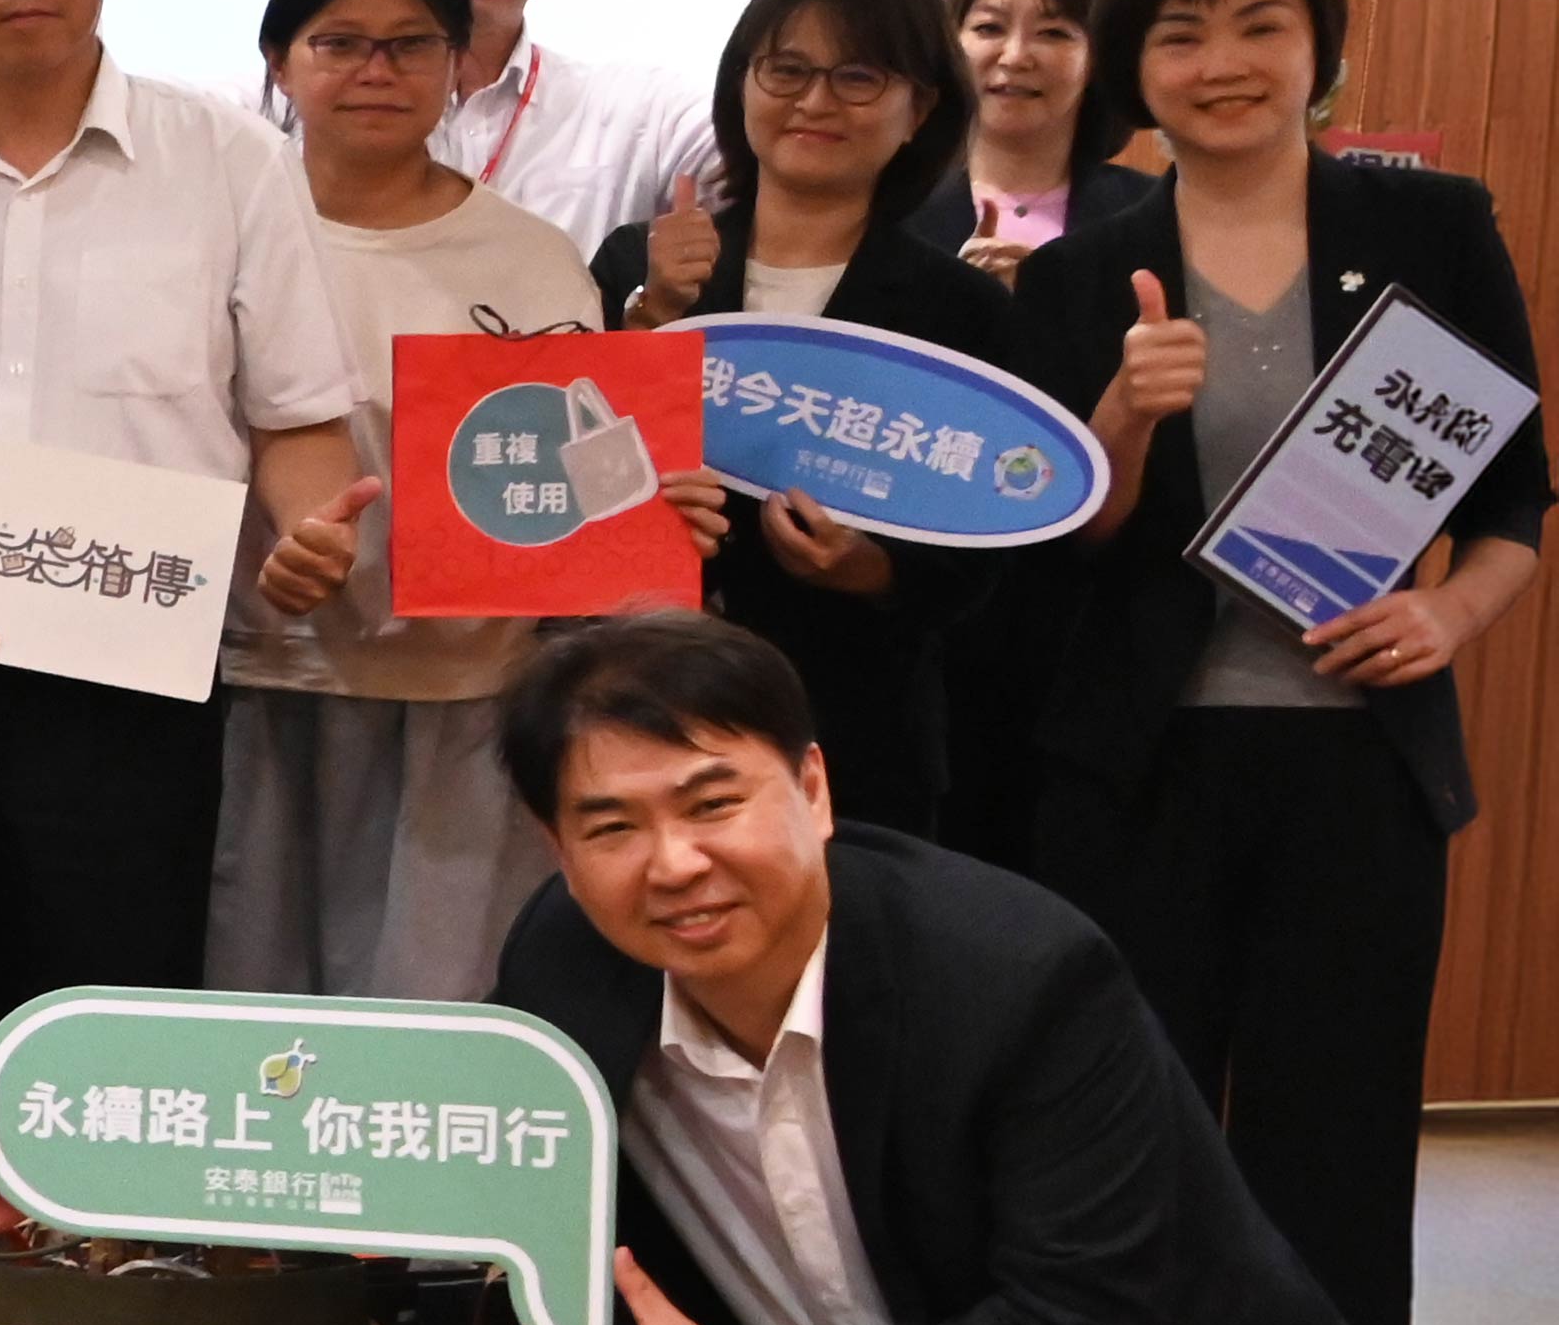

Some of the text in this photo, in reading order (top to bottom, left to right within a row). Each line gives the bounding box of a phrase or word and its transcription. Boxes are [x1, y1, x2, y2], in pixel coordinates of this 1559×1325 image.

[471, 431, 539, 467] 重複
[502, 481, 568, 515] 使用
[17, 1080, 571, 1170] 永續路上 你我同行
[205, 1166, 317, 1197] 安泰銀行
